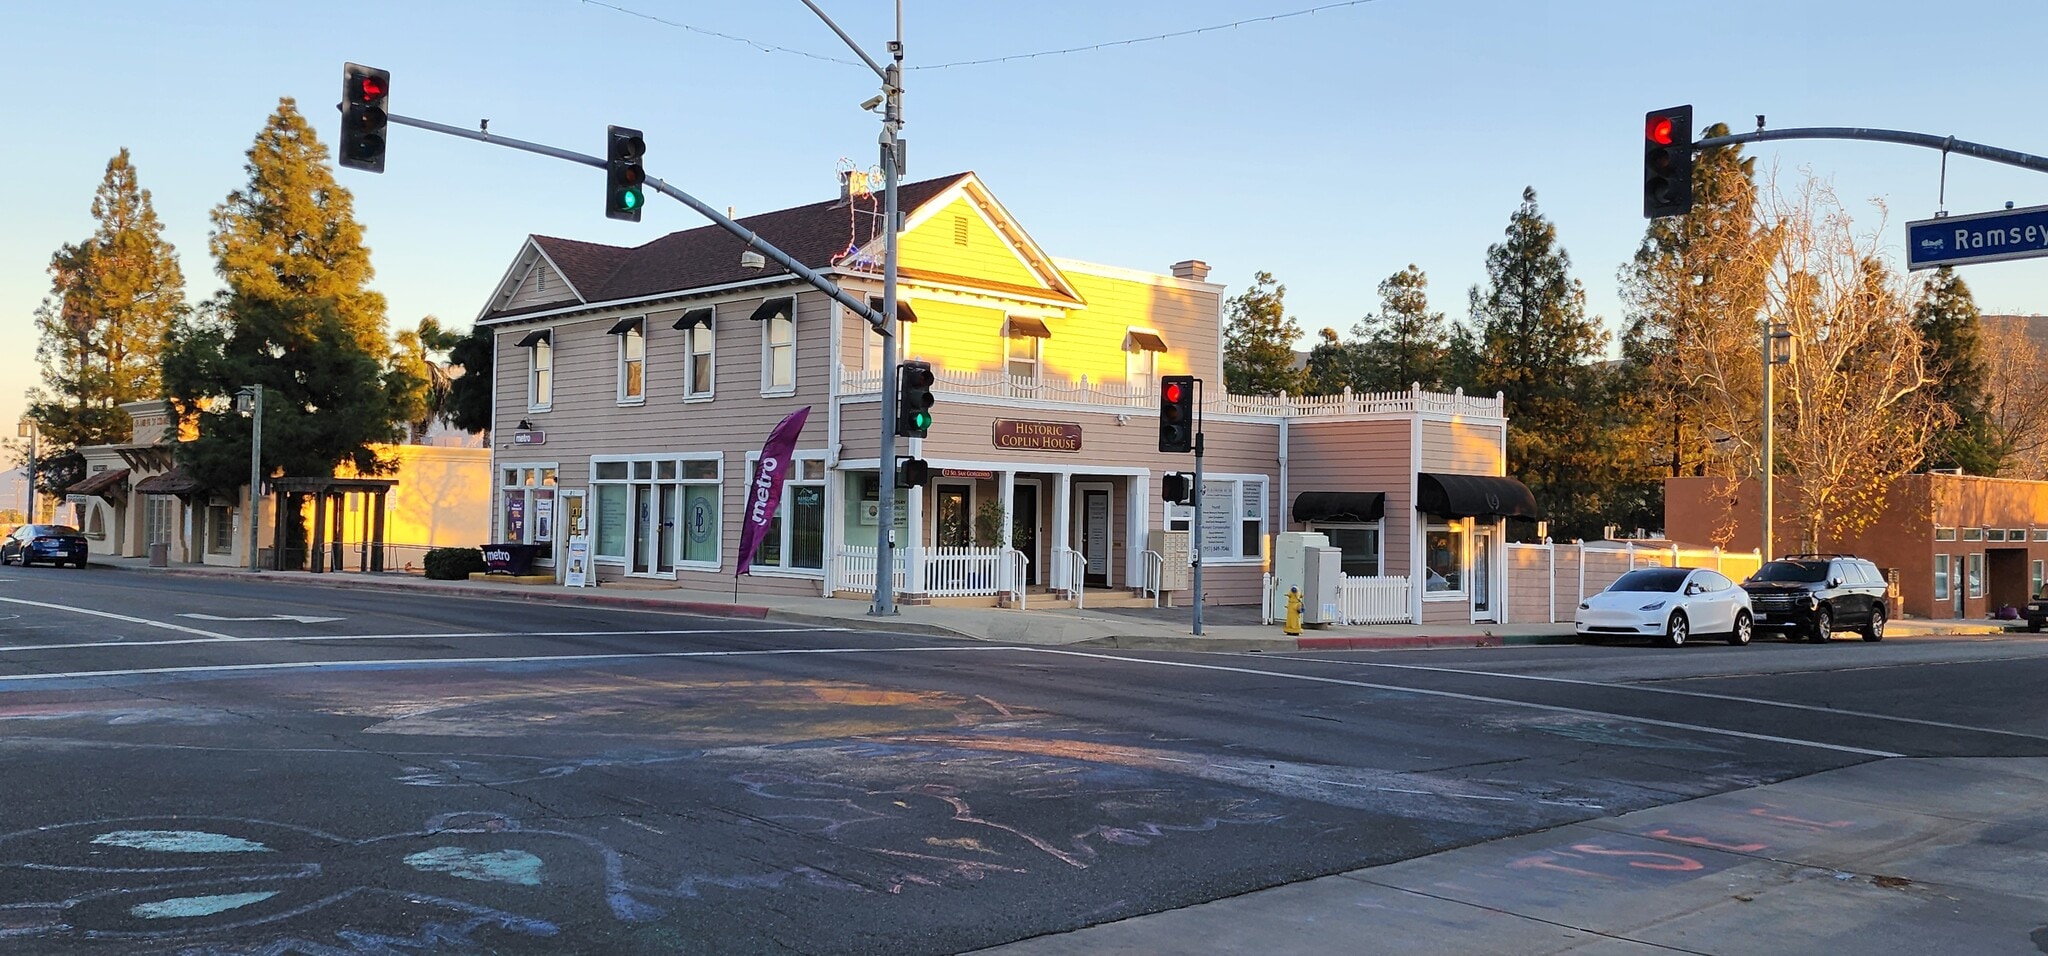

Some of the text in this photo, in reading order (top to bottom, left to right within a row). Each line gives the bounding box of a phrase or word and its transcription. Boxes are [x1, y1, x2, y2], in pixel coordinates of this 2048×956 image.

[1015, 422, 1063, 436] HISTORIC
[516, 434, 531, 442] metro
[1001, 434, 1076, 449] COPLIN HOUSE
[752, 457, 777, 525] metro
[486, 549, 511, 562] metro
